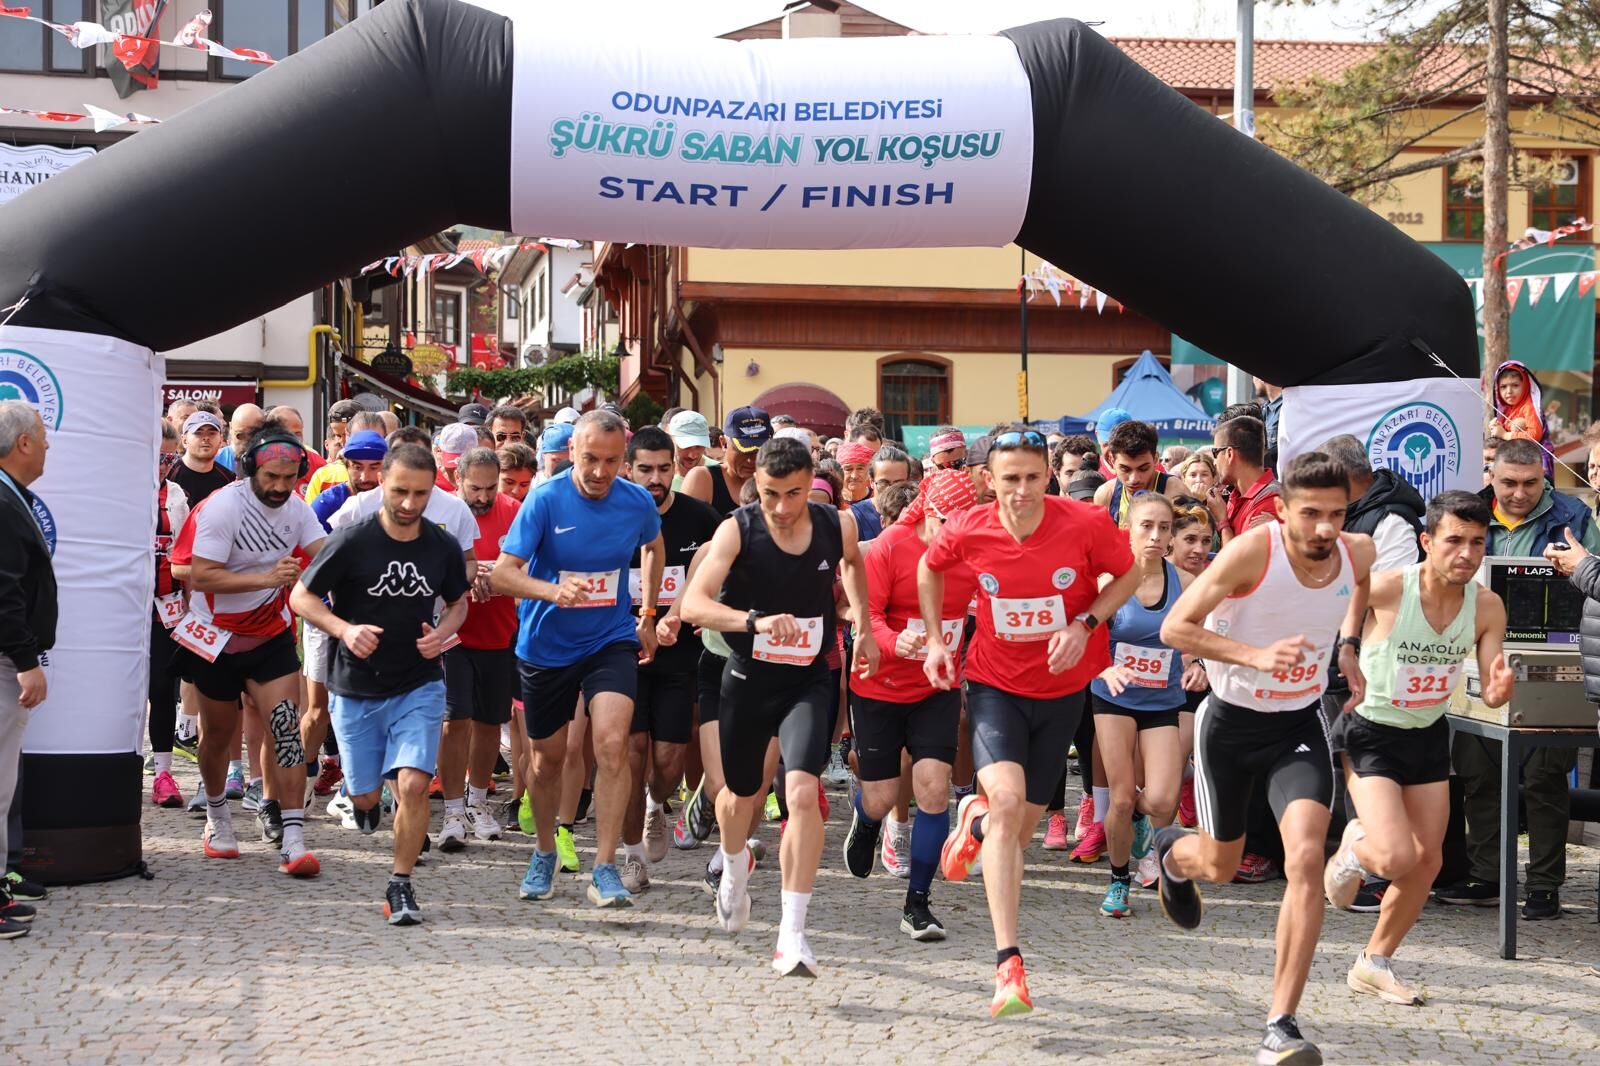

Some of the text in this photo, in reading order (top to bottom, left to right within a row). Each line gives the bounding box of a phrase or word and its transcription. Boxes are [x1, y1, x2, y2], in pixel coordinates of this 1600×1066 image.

[611, 91, 787, 122] ODUNPAZARI
[549, 112, 1003, 168] ŞÜKRÜ SABAN YOL KOŞUSU
[598, 176, 955, 211] START / FINISH
[1388, 211, 1424, 225] 2012
[167, 389, 222, 401] SALONU
[1373, 409, 1419, 471] DUNPAZARI
[1507, 566, 1554, 576] MYLAPS
[1005, 610, 1054, 628] 378
[184, 620, 218, 646] 453
[1505, 631, 1547, 639] chronomix
[1398, 641, 1467, 656] ANATOLIA
[1123, 655, 1162, 674] 259
[1406, 675, 1449, 694] 321
